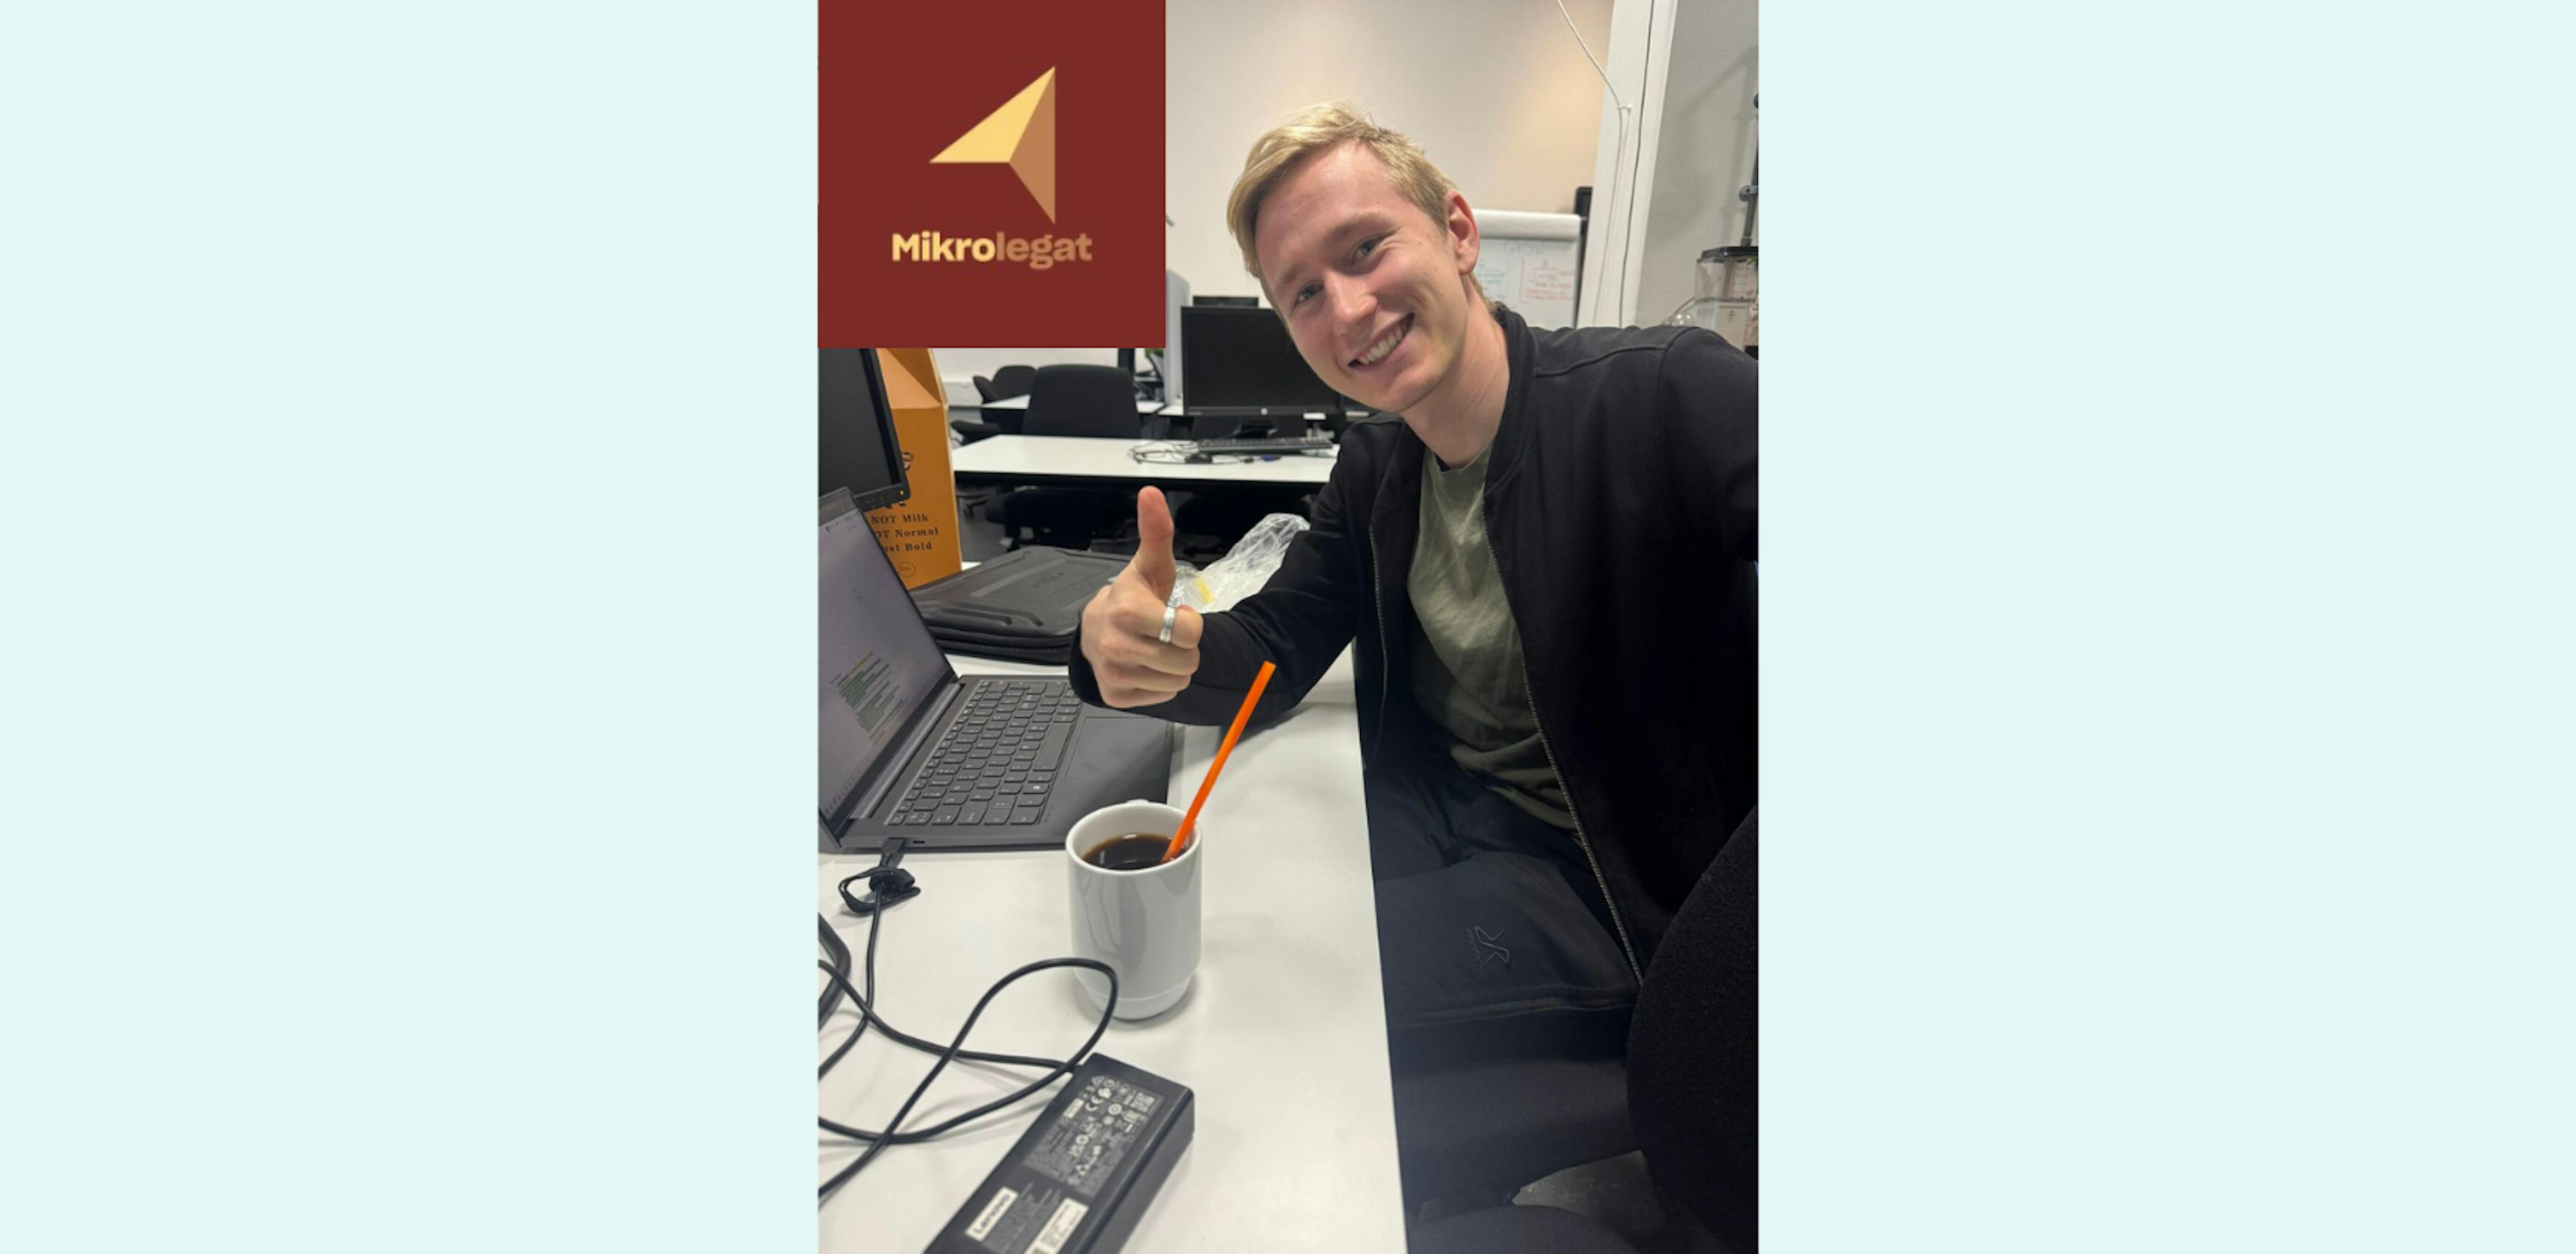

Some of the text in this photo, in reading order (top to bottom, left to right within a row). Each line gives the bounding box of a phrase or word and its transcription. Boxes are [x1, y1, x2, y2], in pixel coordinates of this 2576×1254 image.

[871, 515, 896, 523] NOT
[902, 513, 928, 523] Milk
[874, 526, 938, 538] OT Normal
[905, 541, 932, 551] Bold
[973, 1193, 1011, 1234] Lenovo
